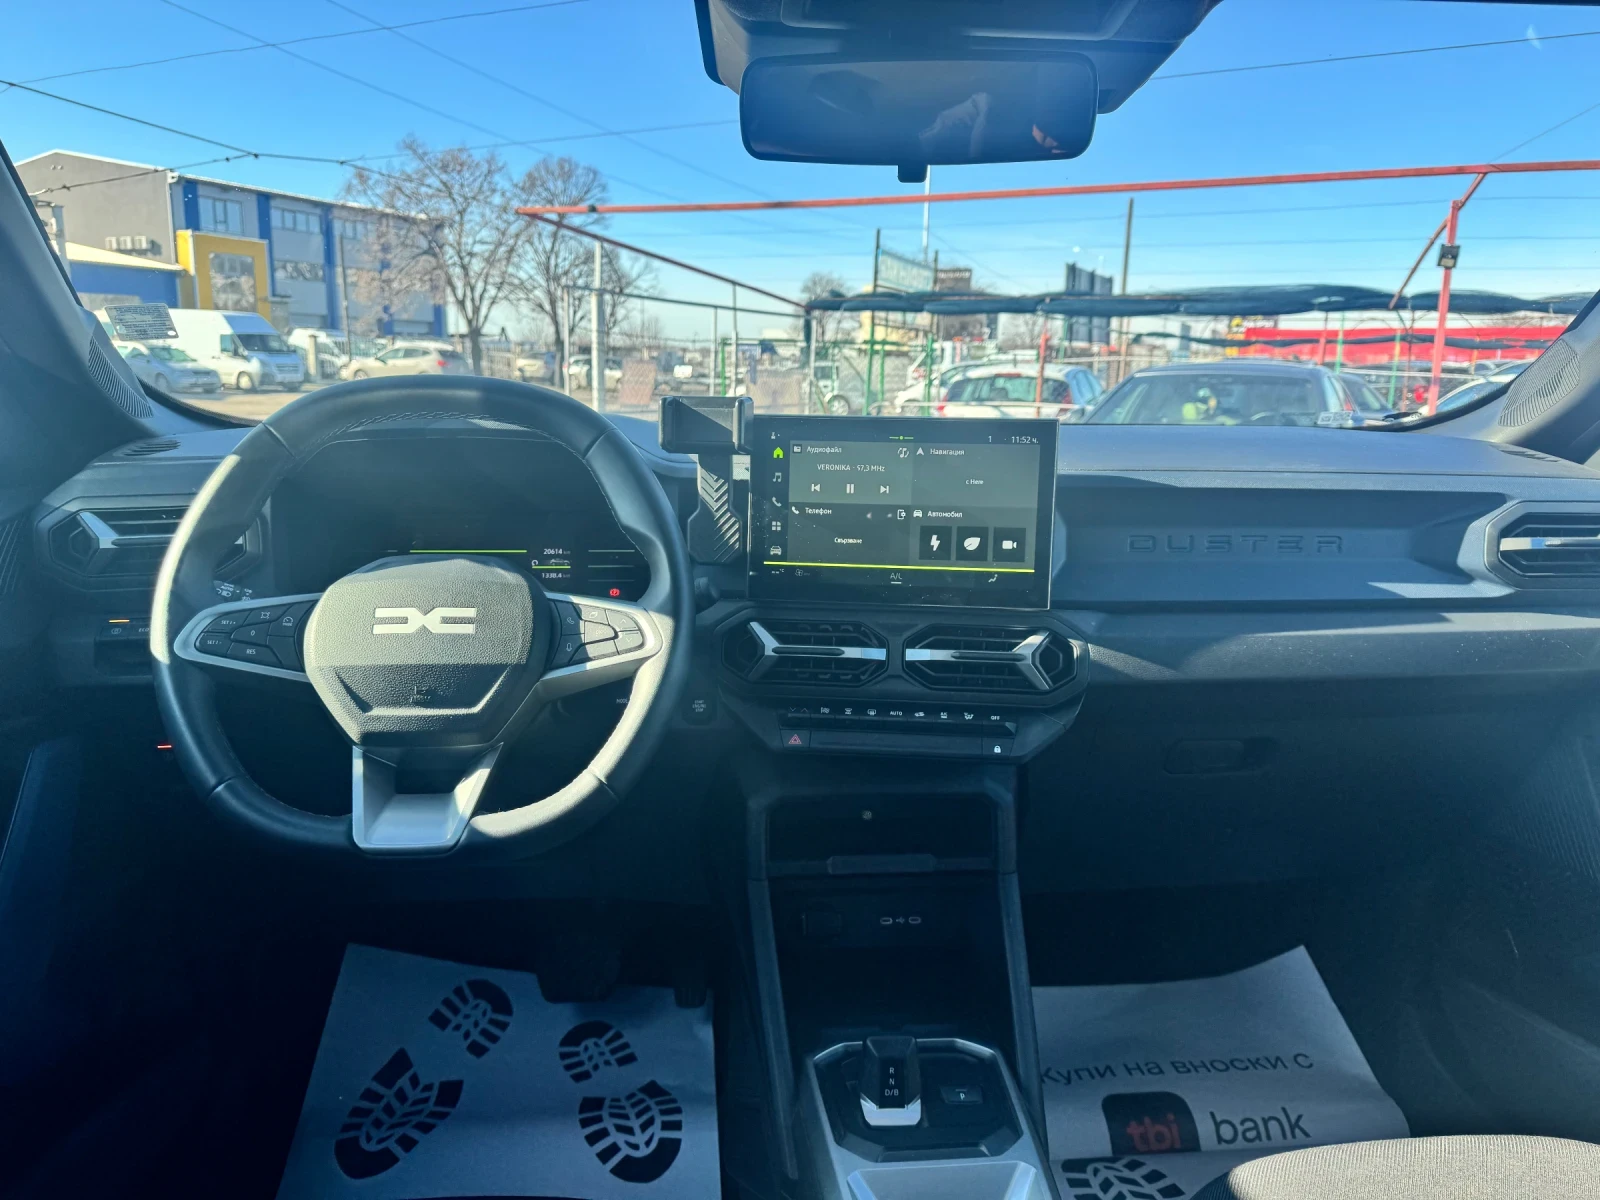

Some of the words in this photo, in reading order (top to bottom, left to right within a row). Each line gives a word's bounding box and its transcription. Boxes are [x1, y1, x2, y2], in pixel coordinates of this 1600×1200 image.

[1011, 436, 1031, 444] 11:52
[806, 446, 842, 454] Аудиофайл
[930, 448, 965, 456] Навигация
[805, 507, 832, 515] Телефон
[927, 510, 963, 518] Автомобил
[834, 537, 863, 545] Свързване
[1127, 534, 1343, 553] DUSTER
[1040, 1064, 1117, 1087] Купи
[1123, 1060, 1165, 1077] на
[1169, 1052, 1287, 1075] вноски
[889, 1078, 895, 1086] N
[1125, 1112, 1181, 1151] tbi
[1209, 1106, 1312, 1146] bank
